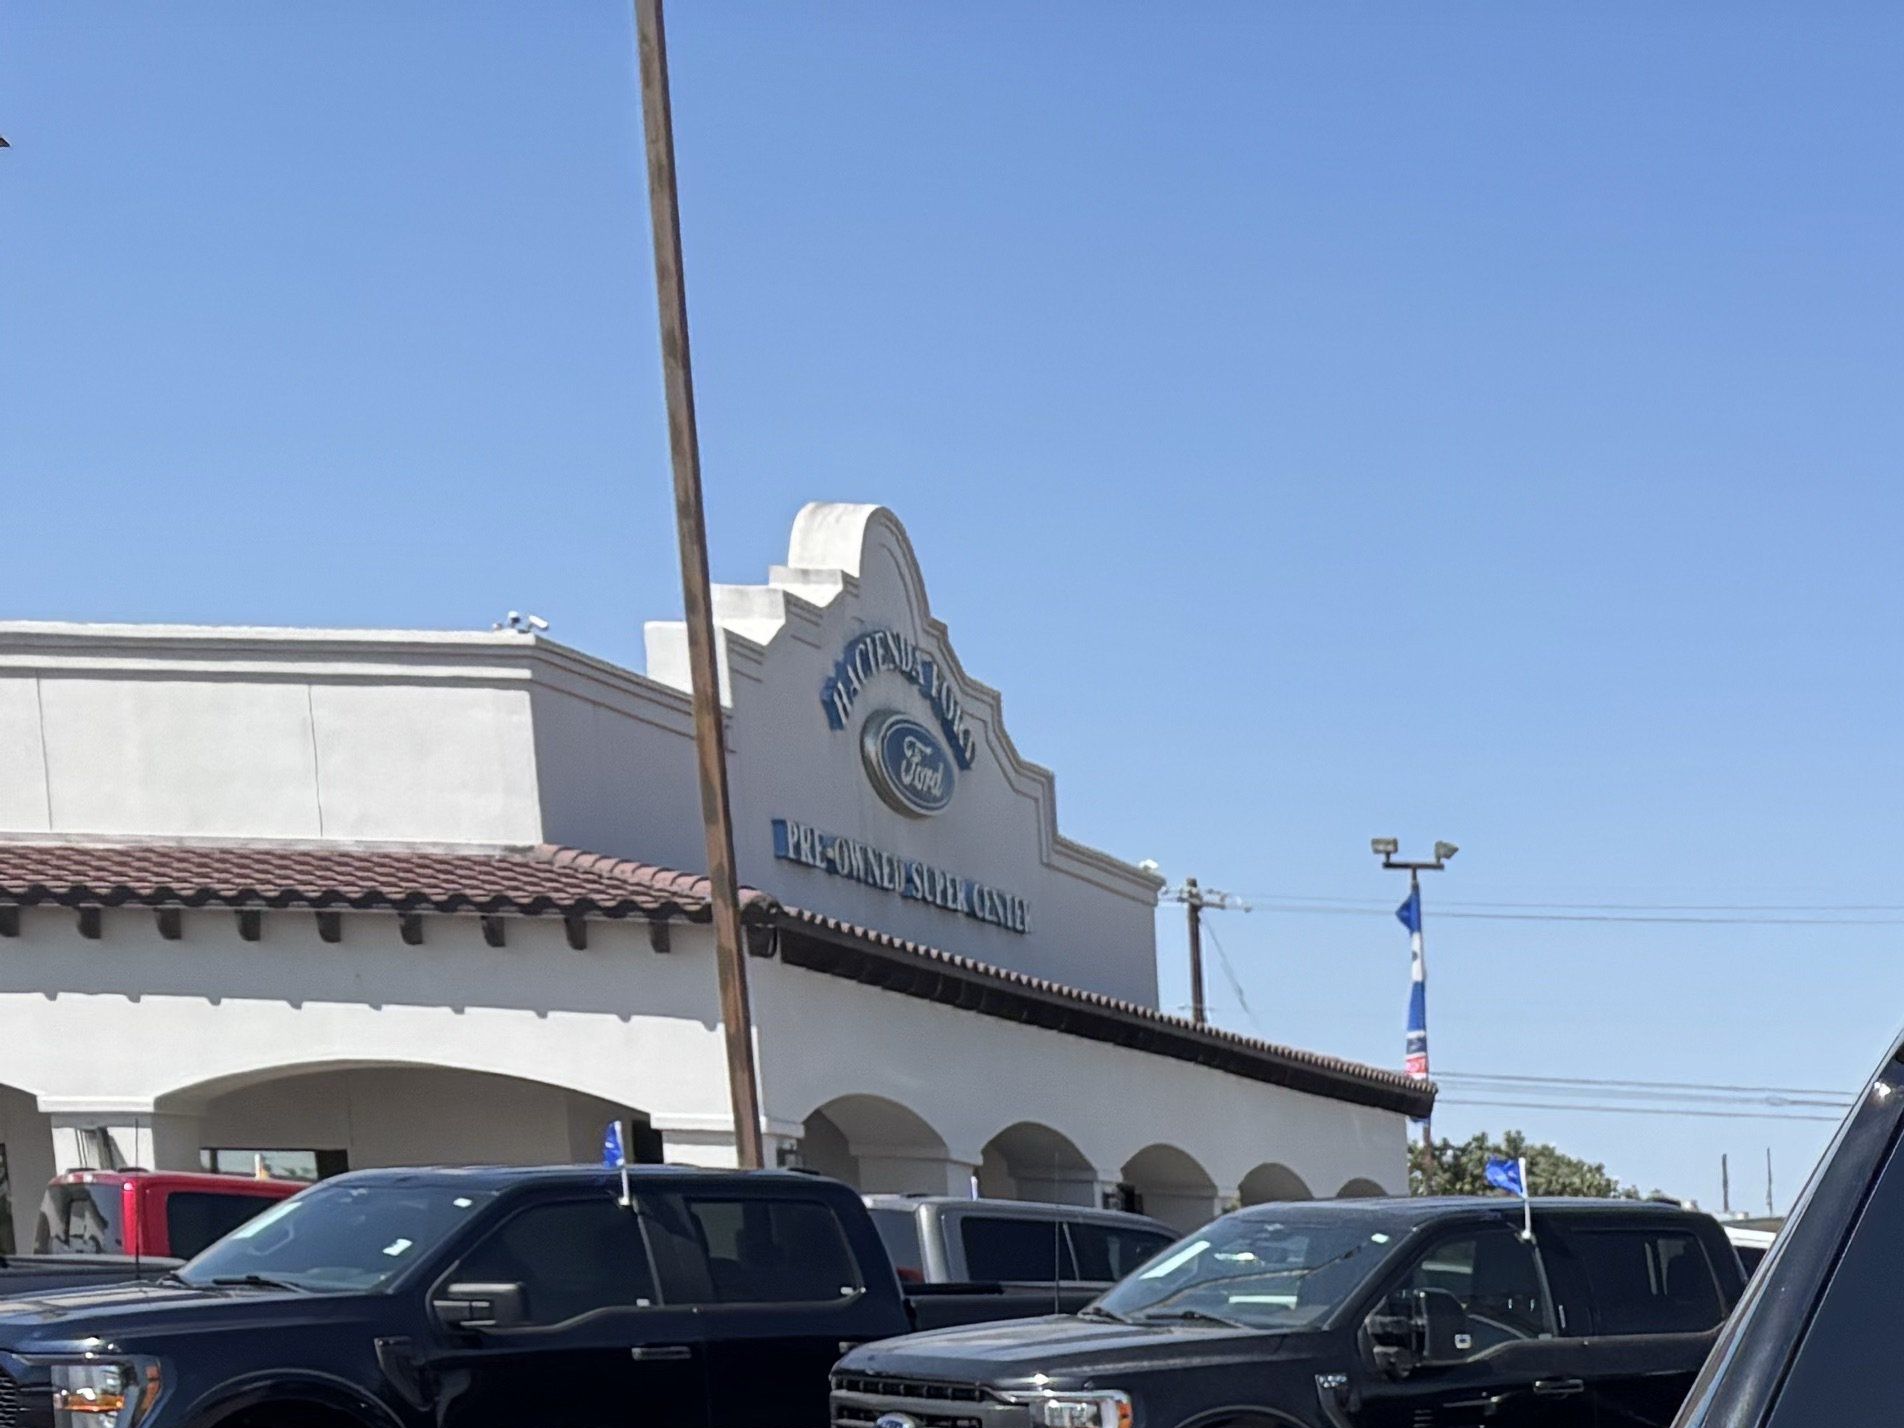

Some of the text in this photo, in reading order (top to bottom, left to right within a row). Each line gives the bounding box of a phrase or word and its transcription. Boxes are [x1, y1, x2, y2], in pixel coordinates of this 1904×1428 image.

[829, 628, 926, 726] HACIENDA
[900, 735, 944, 798] Ford
[783, 819, 1031, 933] PRE-OWNED SUPER CENTER
